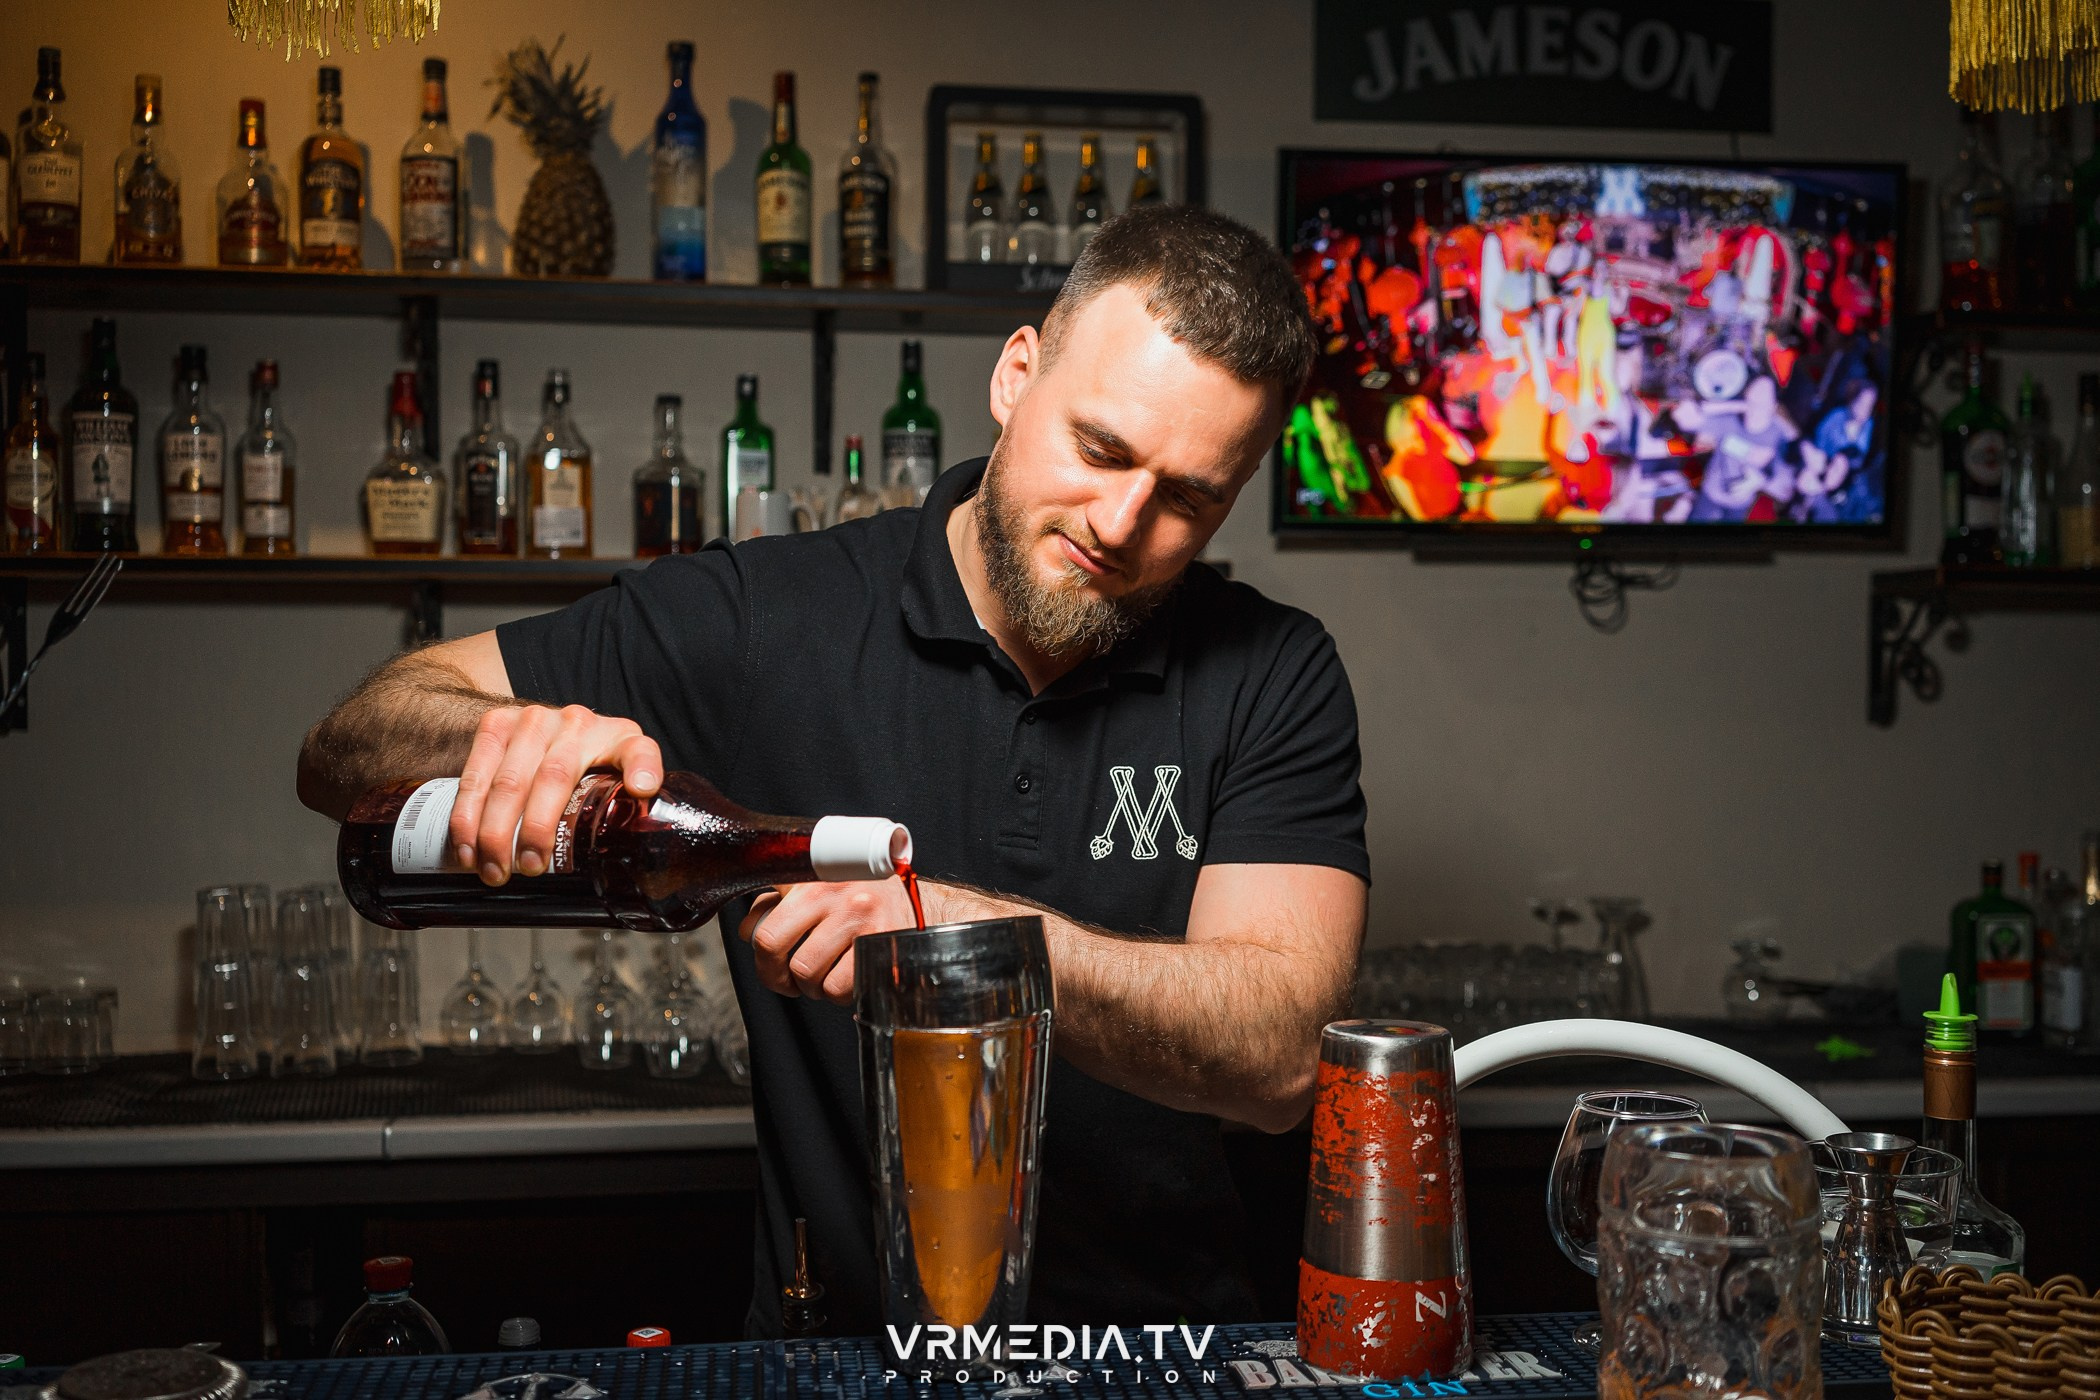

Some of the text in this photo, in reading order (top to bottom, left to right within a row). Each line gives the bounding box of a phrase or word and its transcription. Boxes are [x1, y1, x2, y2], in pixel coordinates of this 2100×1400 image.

[1353, 6, 1734, 111] JAMESON
[555, 820, 567, 868] MONIN
[1361, 1380, 1469, 1399] GIN
